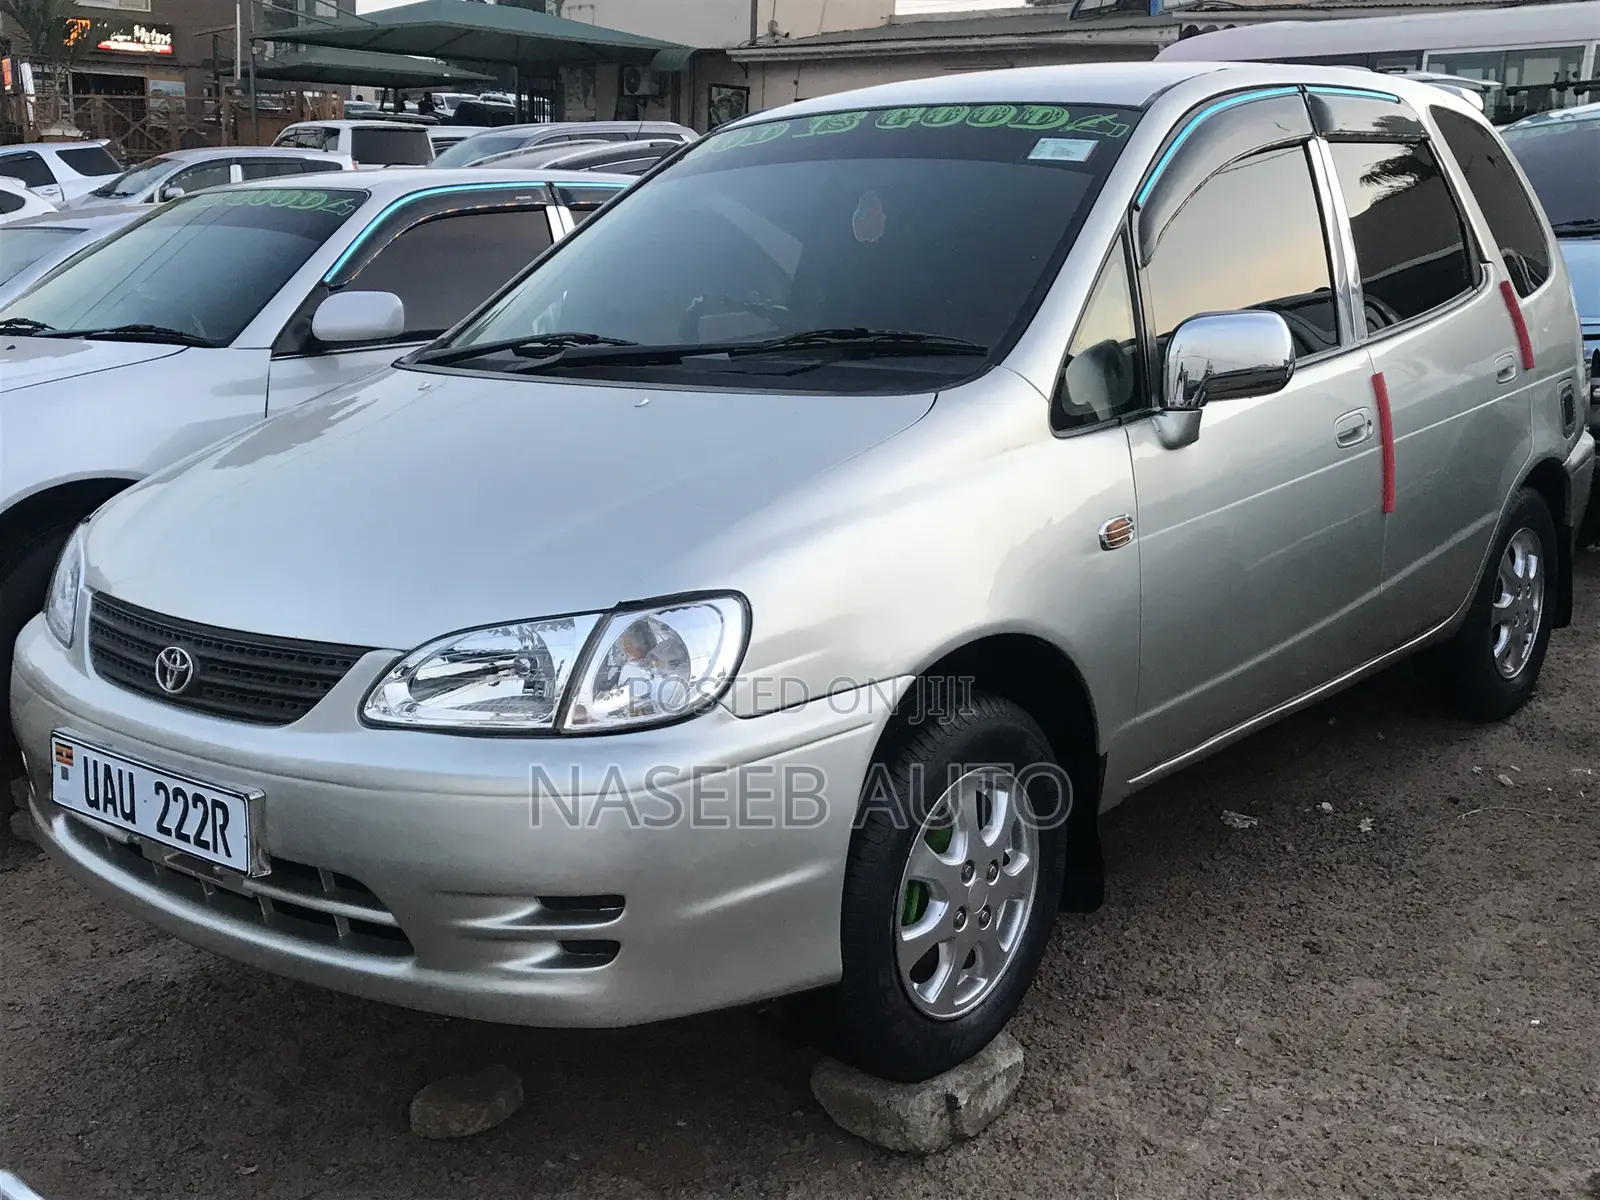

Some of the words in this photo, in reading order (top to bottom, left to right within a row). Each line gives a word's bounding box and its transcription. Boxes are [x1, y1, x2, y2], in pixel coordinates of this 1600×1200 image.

[791, 110, 870, 139] IS
[875, 104, 1070, 130] GOOD
[83, 755, 136, 825] UAU
[154, 780, 232, 858] 222R
